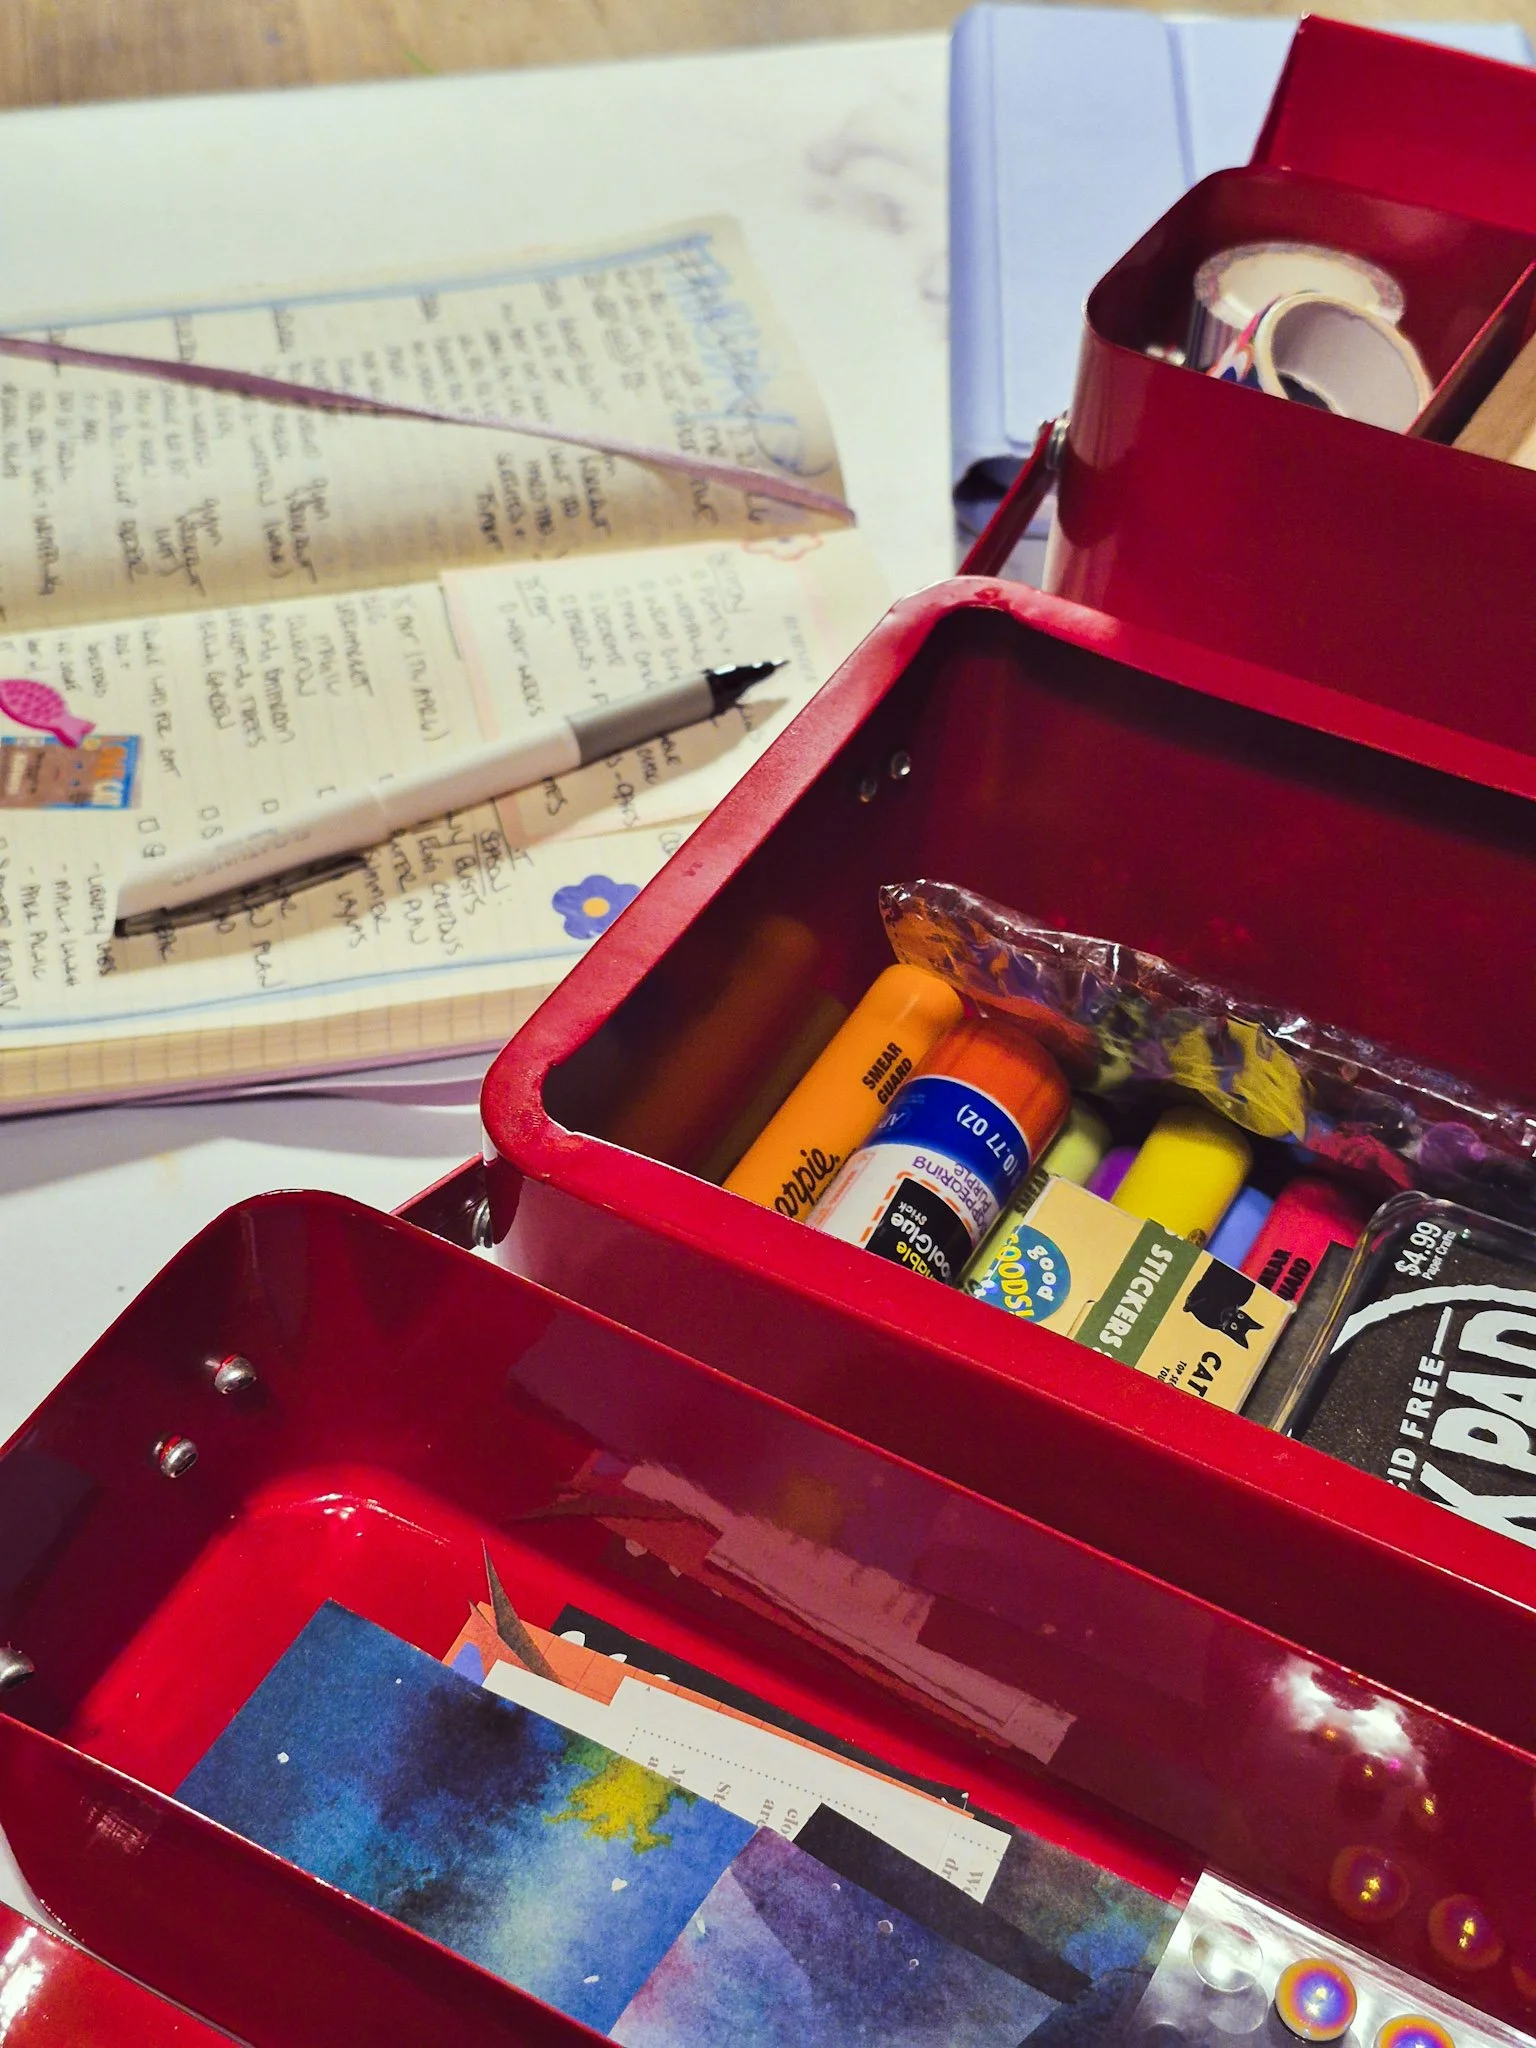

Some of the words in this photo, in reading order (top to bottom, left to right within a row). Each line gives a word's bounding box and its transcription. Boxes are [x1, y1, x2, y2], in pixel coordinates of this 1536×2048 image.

[861, 1042, 904, 1091] SMEAR
[876, 1057, 914, 1106] GUARD
[956, 1103, 989, 1137] OZ)
[897, 1200, 928, 1226] Stick
[1026, 1244, 1057, 1302] good
[1394, 1221, 1443, 1277] $4.99
[1421, 1251, 1444, 1281] Paper
[1434, 1229, 1458, 1257] Crafts
[1099, 1243, 1174, 1349] STICKERS
[1400, 1355, 1445, 1440] FREE
